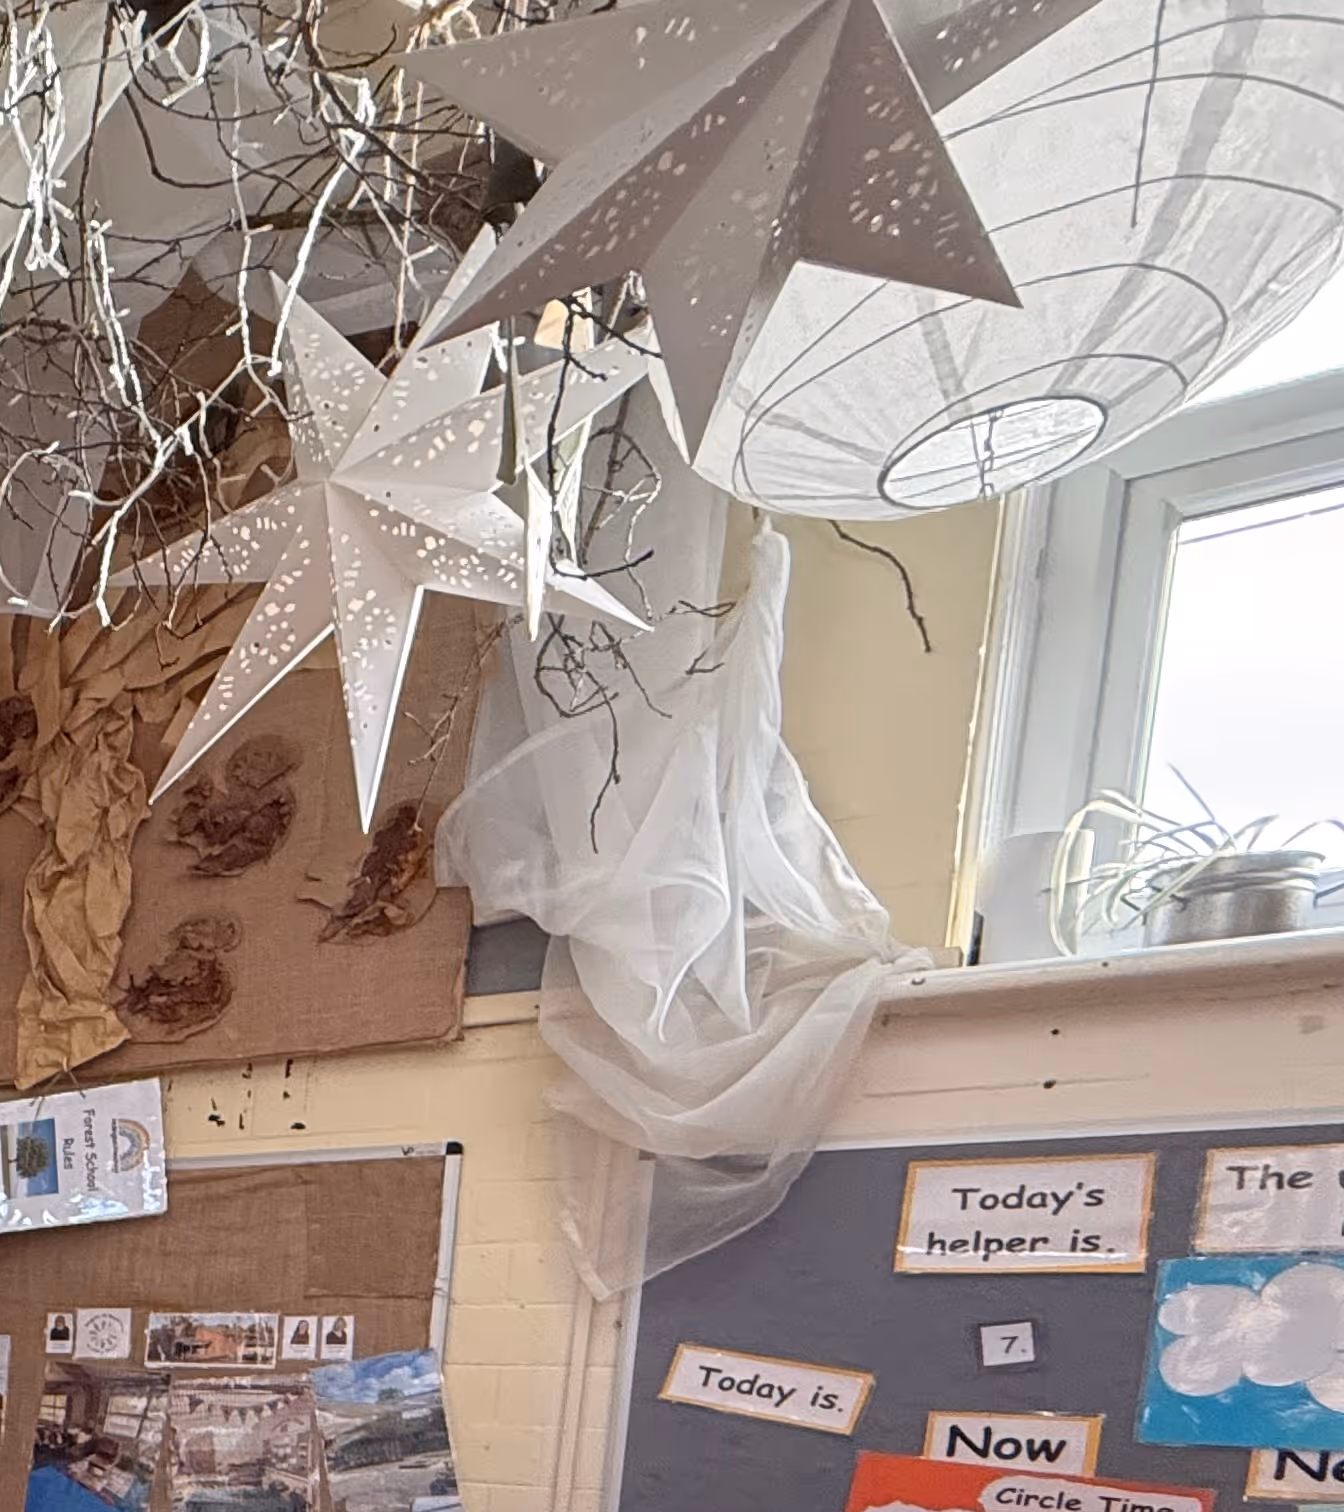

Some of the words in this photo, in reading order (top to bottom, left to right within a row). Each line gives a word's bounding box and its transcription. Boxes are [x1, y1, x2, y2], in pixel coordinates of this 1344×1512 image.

[83, 1108, 96, 1149] Forest
[63, 1137, 76, 1170] Rules
[85, 1153, 100, 1192] School
[1225, 1164, 1314, 1191] The
[951, 1181, 1106, 1216] Today's
[926, 1230, 1050, 1262] helper
[697, 1364, 795, 1405] Today
[947, 1425, 1068, 1464] Now
